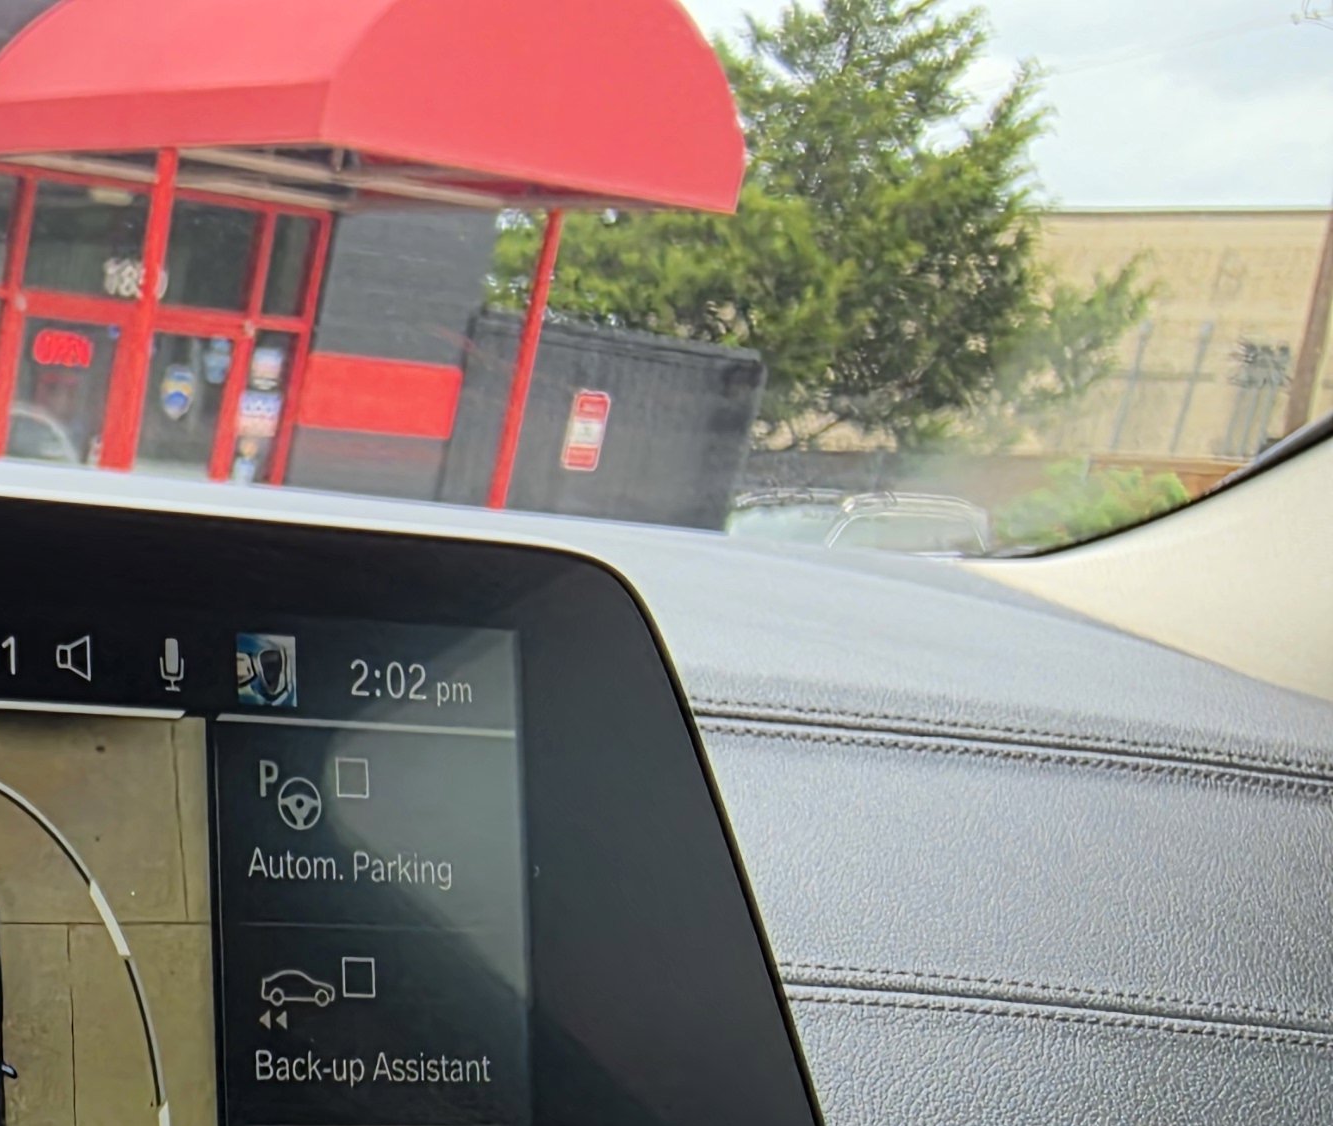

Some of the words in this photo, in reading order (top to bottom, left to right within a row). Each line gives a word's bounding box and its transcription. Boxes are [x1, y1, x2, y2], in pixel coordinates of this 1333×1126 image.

[351, 658, 427, 700] 2:02
[437, 681, 472, 707] pm
[259, 760, 278, 797] P
[248, 847, 344, 881] Autom.
[353, 851, 453, 890] Parking
[255, 1050, 365, 1088] Back-up
[373, 1052, 491, 1083] Assistant
